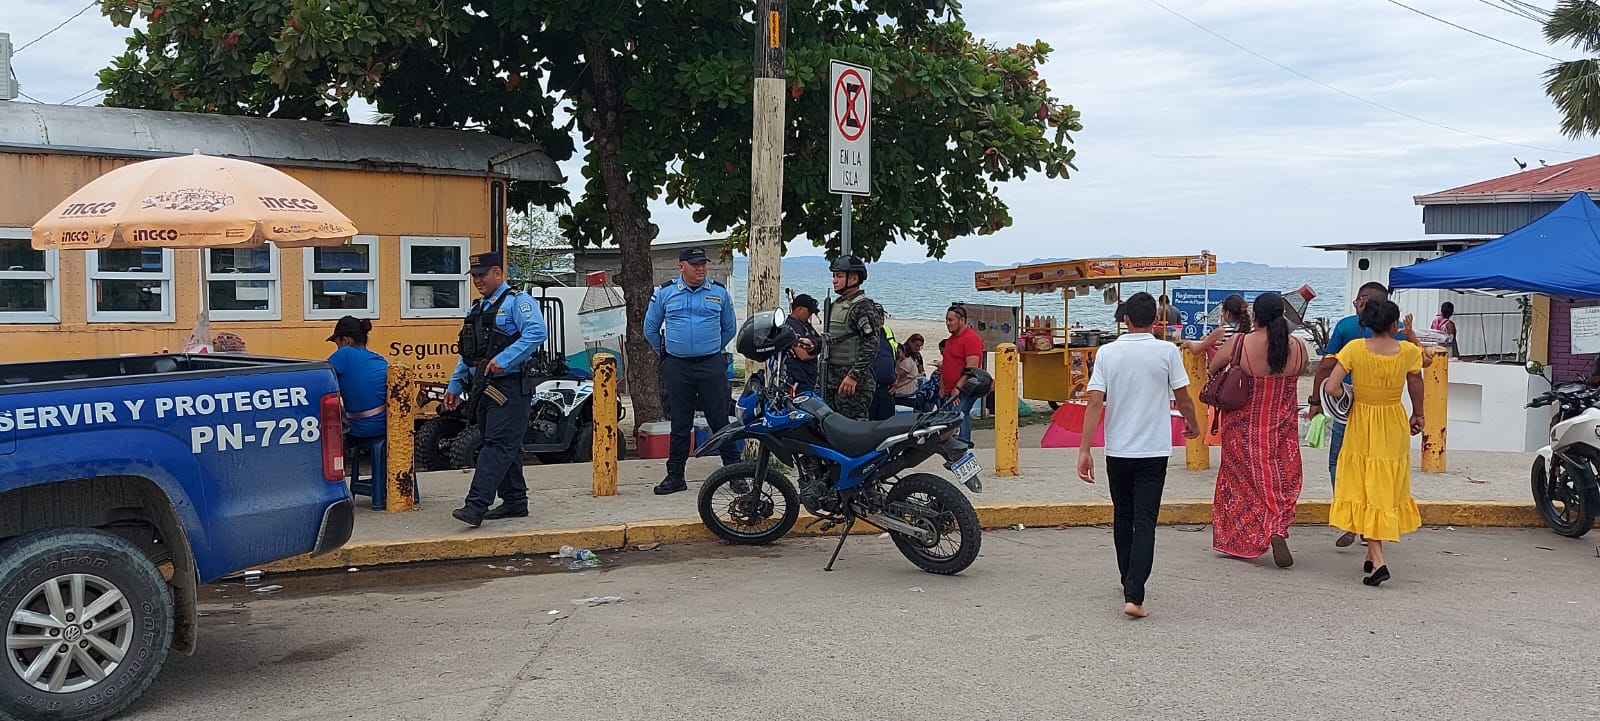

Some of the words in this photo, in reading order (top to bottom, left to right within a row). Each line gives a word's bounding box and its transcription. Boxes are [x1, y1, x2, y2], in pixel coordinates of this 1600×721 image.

[840, 149, 849, 165] EN
[852, 150, 862, 167] LA
[842, 170, 859, 186] ISLA
[0, 401, 117, 432] SERVIR
[123, 399, 145, 421] Y
[155, 386, 310, 418] PROTEGER
[190, 416, 321, 454] PN-728
